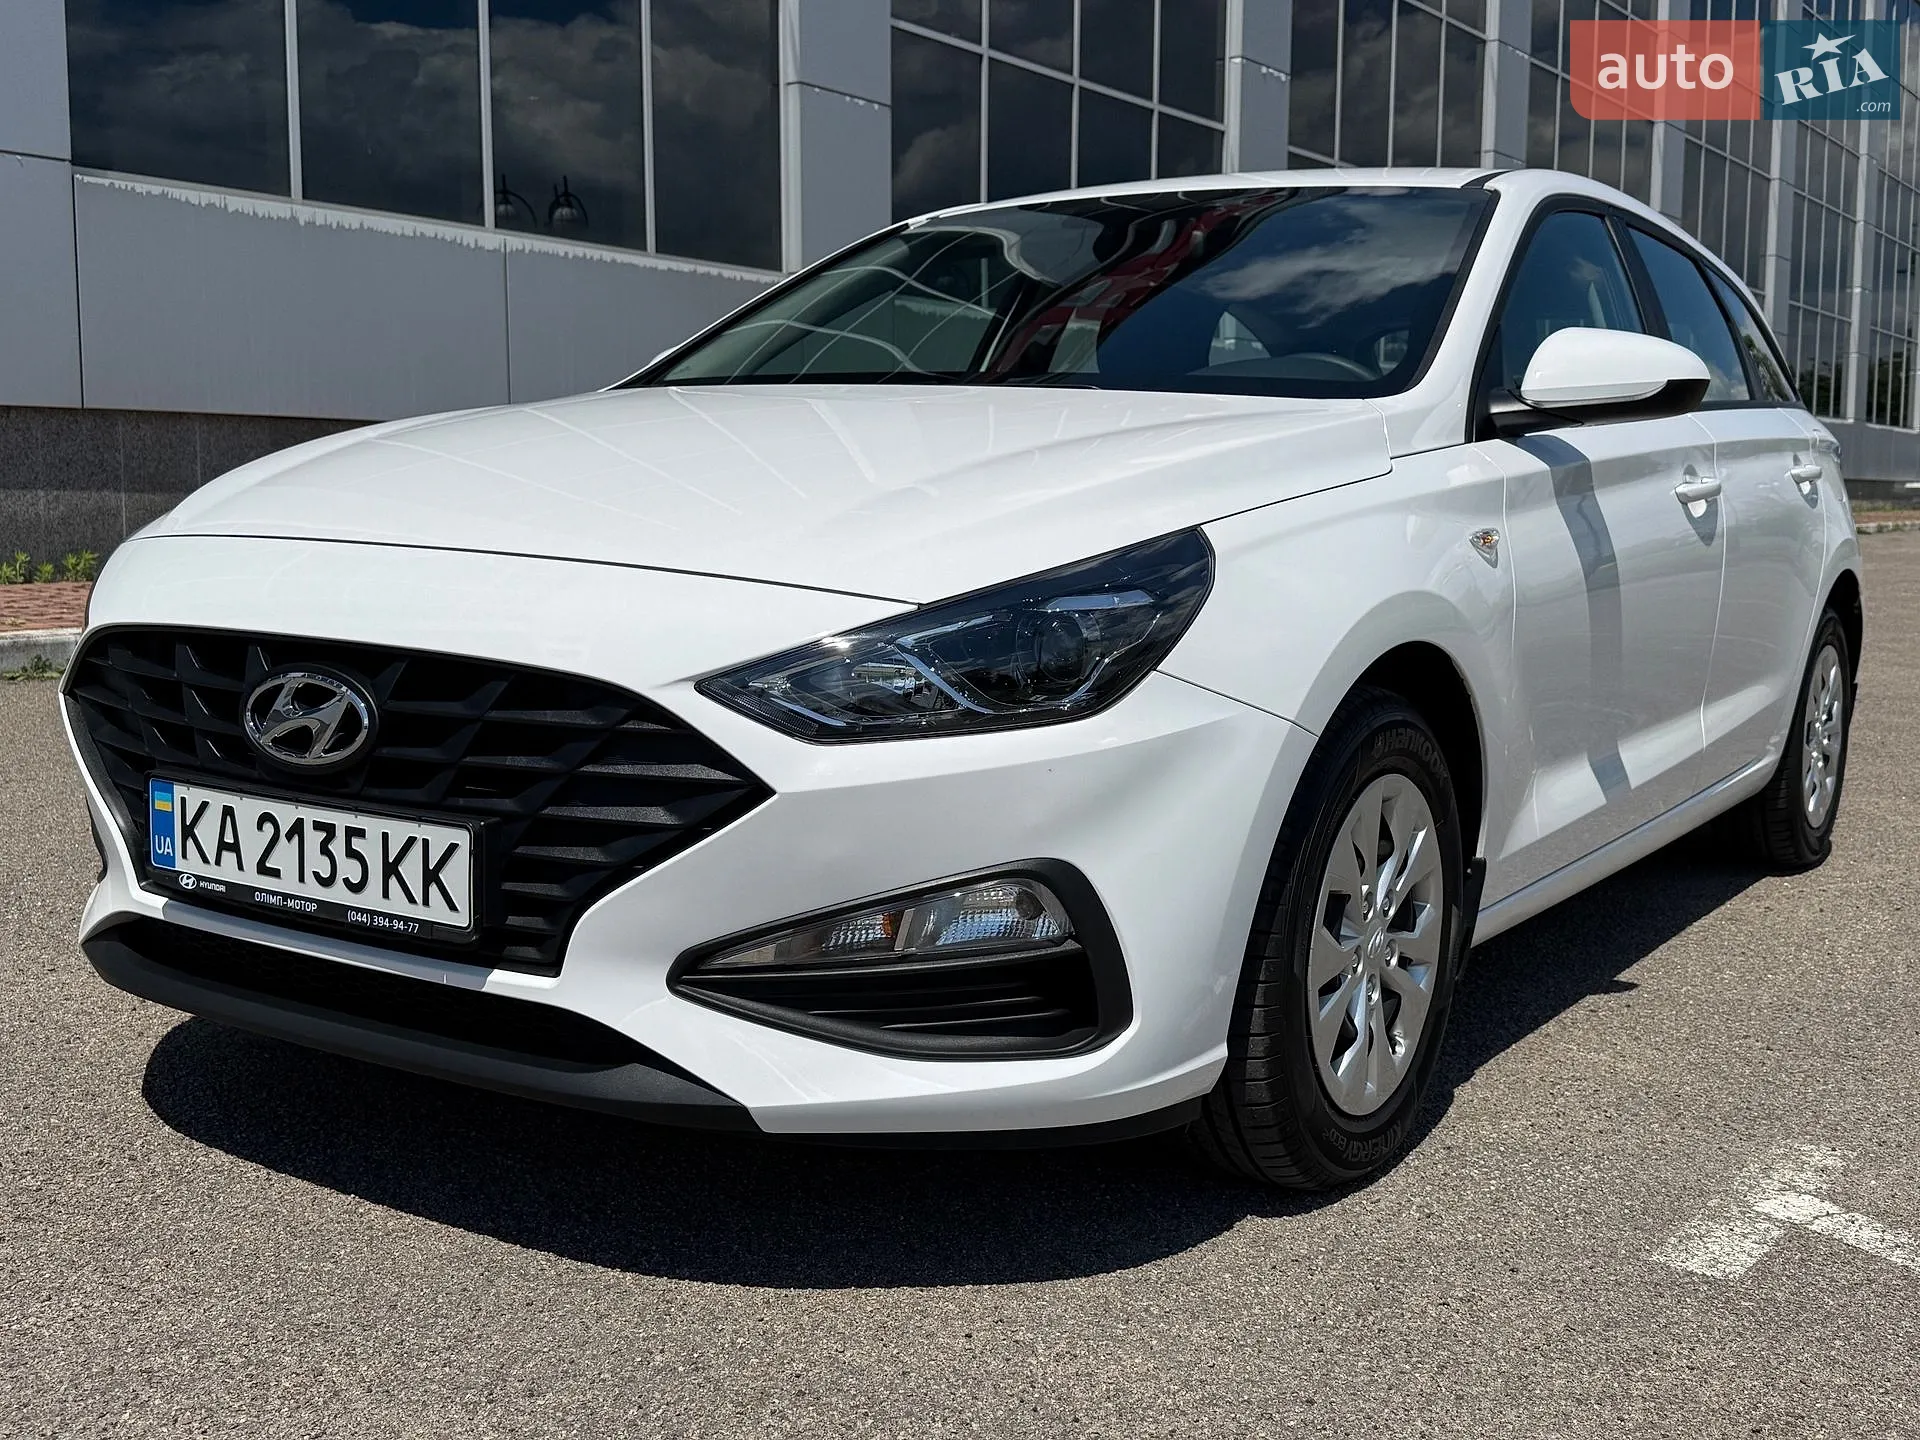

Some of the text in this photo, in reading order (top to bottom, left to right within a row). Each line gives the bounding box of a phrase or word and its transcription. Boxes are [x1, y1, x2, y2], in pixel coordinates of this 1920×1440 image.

[155, 834, 173, 857] UA
[180, 796, 460, 913] KA 2135 KK
[199, 880, 226, 893] HYUNDAI
[254, 891, 318, 913] ОЛІМП-МОТОР
[347, 909, 420, 934] (044) 394-94-77
